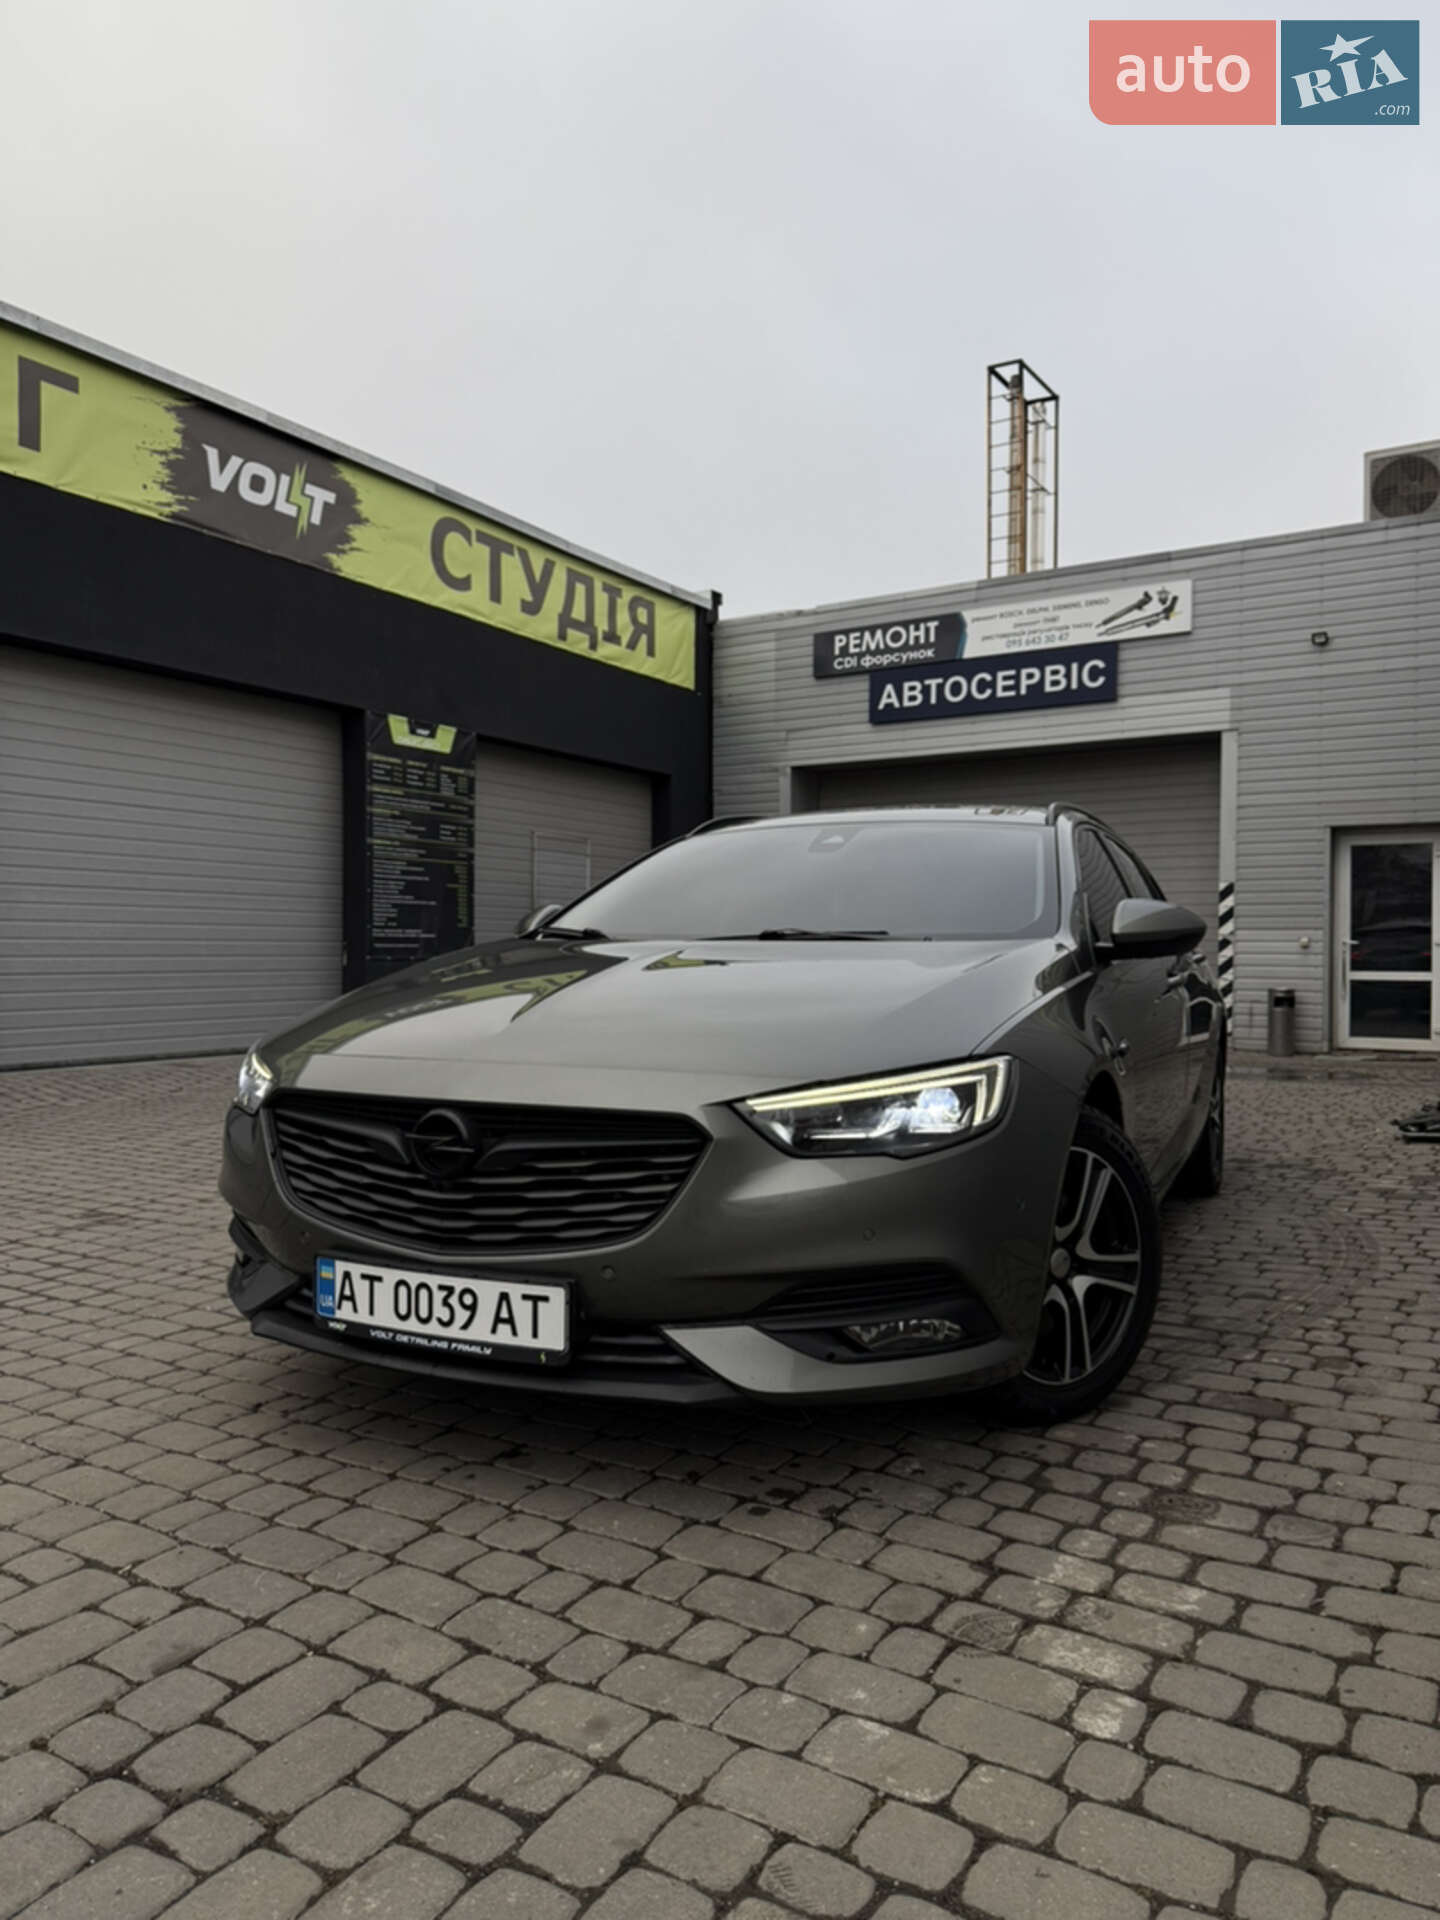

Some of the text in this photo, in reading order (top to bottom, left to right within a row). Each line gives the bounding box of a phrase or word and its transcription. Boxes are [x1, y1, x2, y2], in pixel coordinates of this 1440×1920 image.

[18, 355, 80, 453] Г
[202, 444, 337, 528] VOLT
[429, 517, 657, 659] СТУДІЯ
[833, 620, 940, 656] РЕМОНТ
[833, 648, 936, 671] CDI форсунок
[877, 659, 1107, 711] АВТОСЕРВІС
[336, 1270, 550, 1340] AT 0039 AT
[369, 1329, 493, 1355] VOLT DETAILING FAMILY
